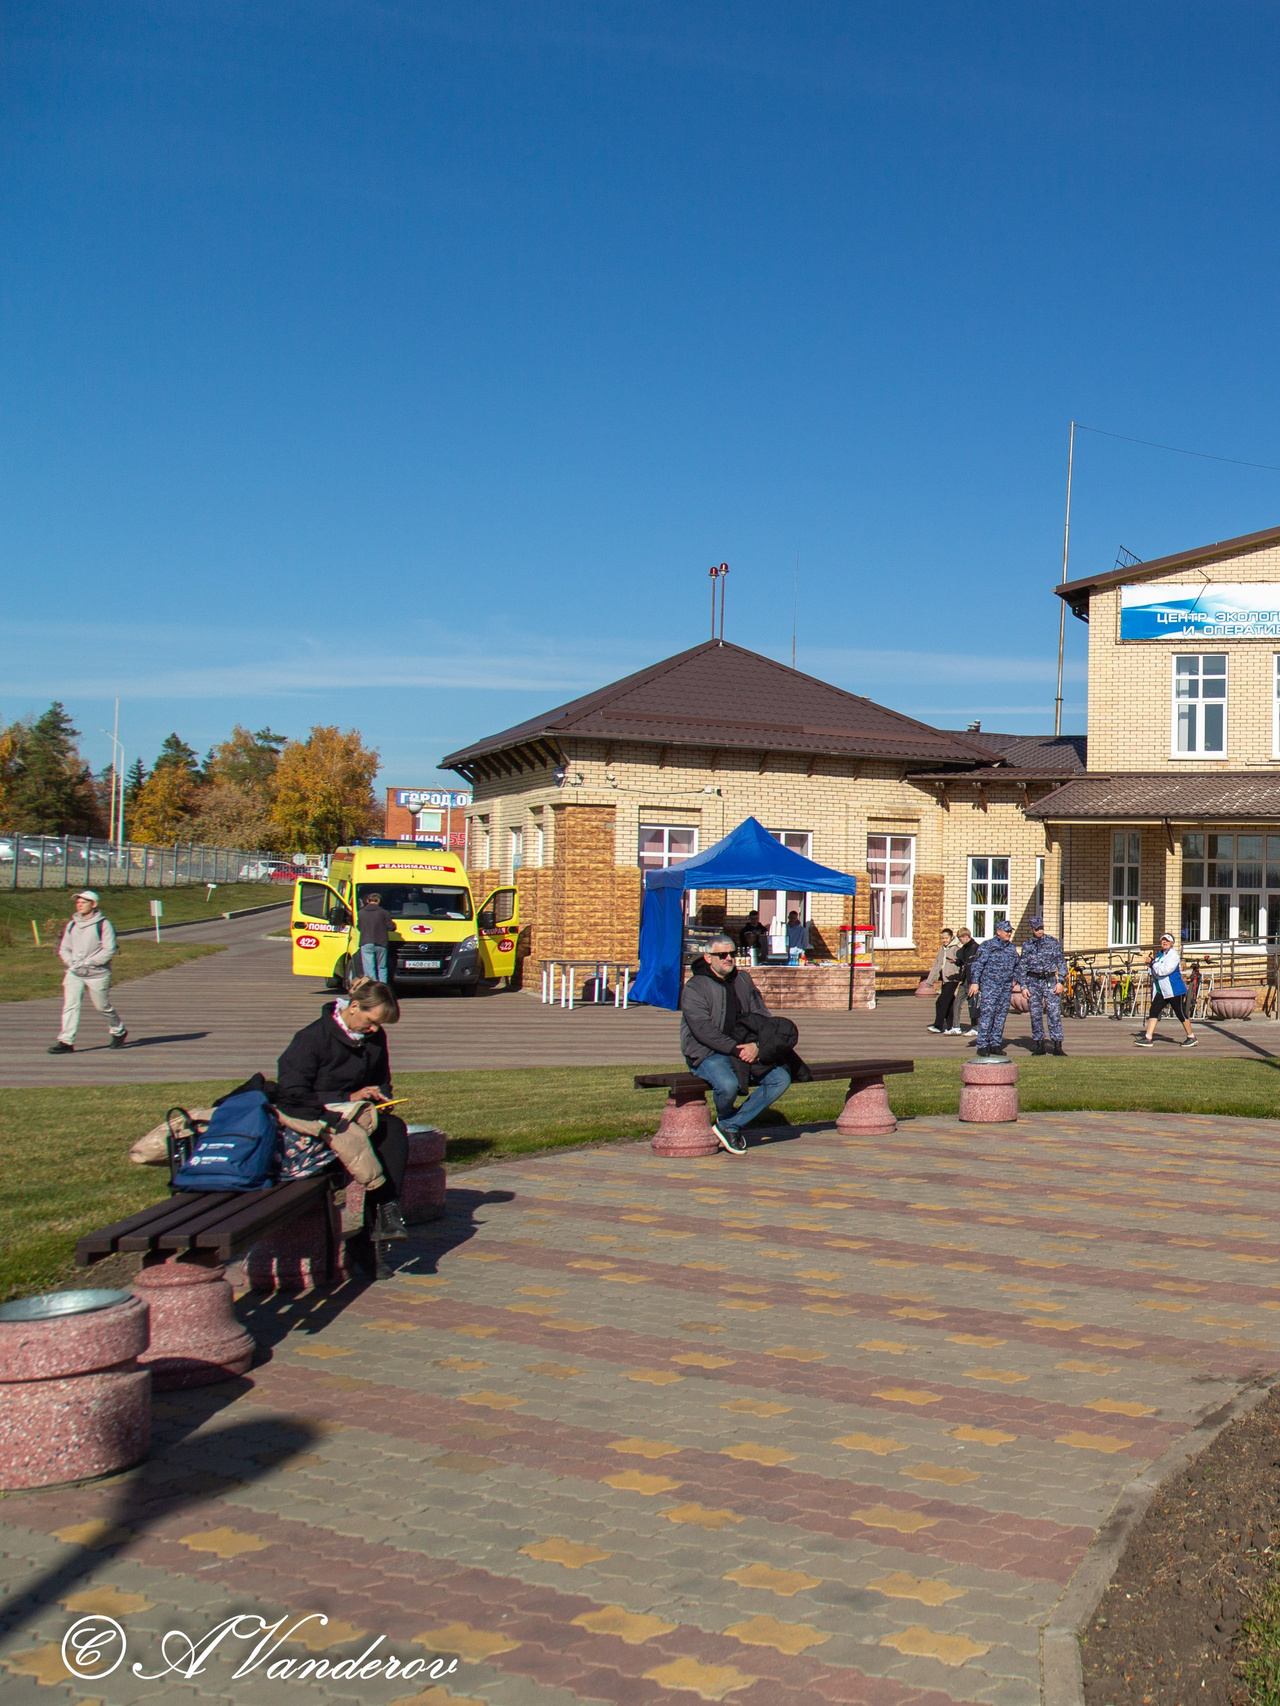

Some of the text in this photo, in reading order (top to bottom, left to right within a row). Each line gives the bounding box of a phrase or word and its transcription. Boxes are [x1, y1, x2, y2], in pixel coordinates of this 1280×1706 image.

[1156, 612, 1208, 625] ЦЕНТР
[1182, 625, 1196, 636] И
[481, 927, 506, 935] СКОРАЯ
[299, 937, 316, 948] 422
[499, 941, 512, 950] 422
